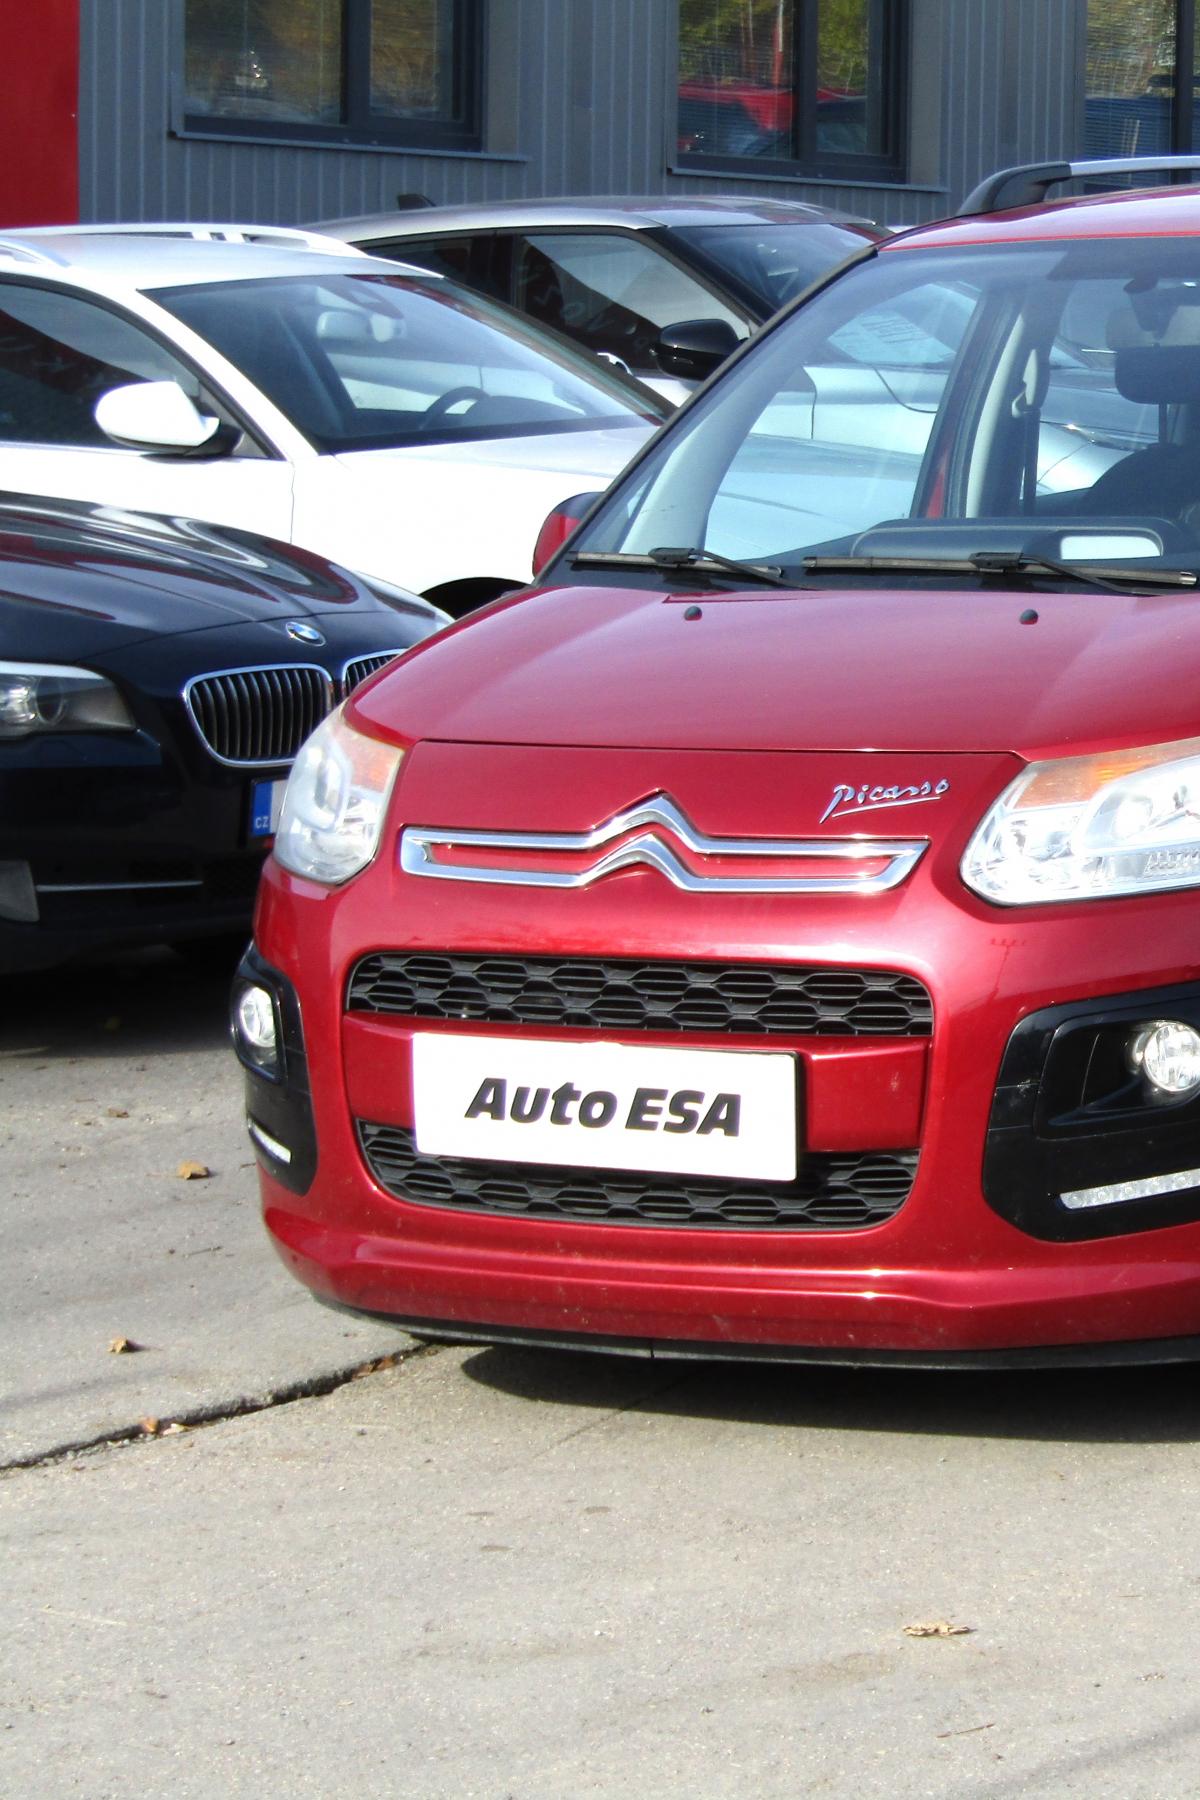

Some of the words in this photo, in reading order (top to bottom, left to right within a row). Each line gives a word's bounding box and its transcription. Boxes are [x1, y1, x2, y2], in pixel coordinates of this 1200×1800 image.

[255, 816, 269, 829] CZ
[464, 1077, 618, 1129] Auto
[625, 1087, 742, 1137] ESA
